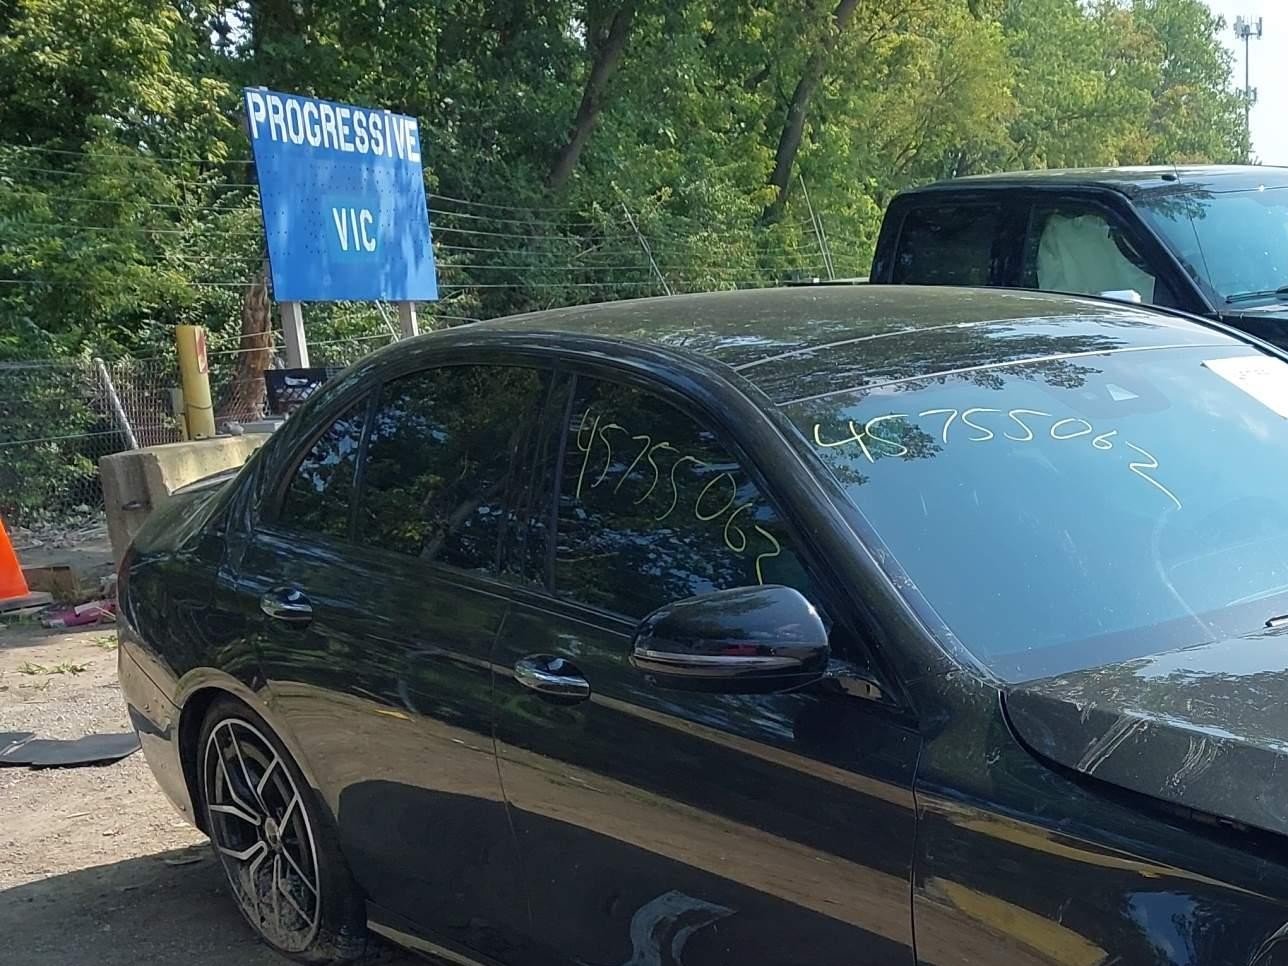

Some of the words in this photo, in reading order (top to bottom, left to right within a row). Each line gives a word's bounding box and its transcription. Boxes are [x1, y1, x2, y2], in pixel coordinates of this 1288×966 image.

[246, 91, 421, 163] PROGRESSIVE
[332, 207, 377, 252] VIC
[813, 407, 1183, 511] 45755062
